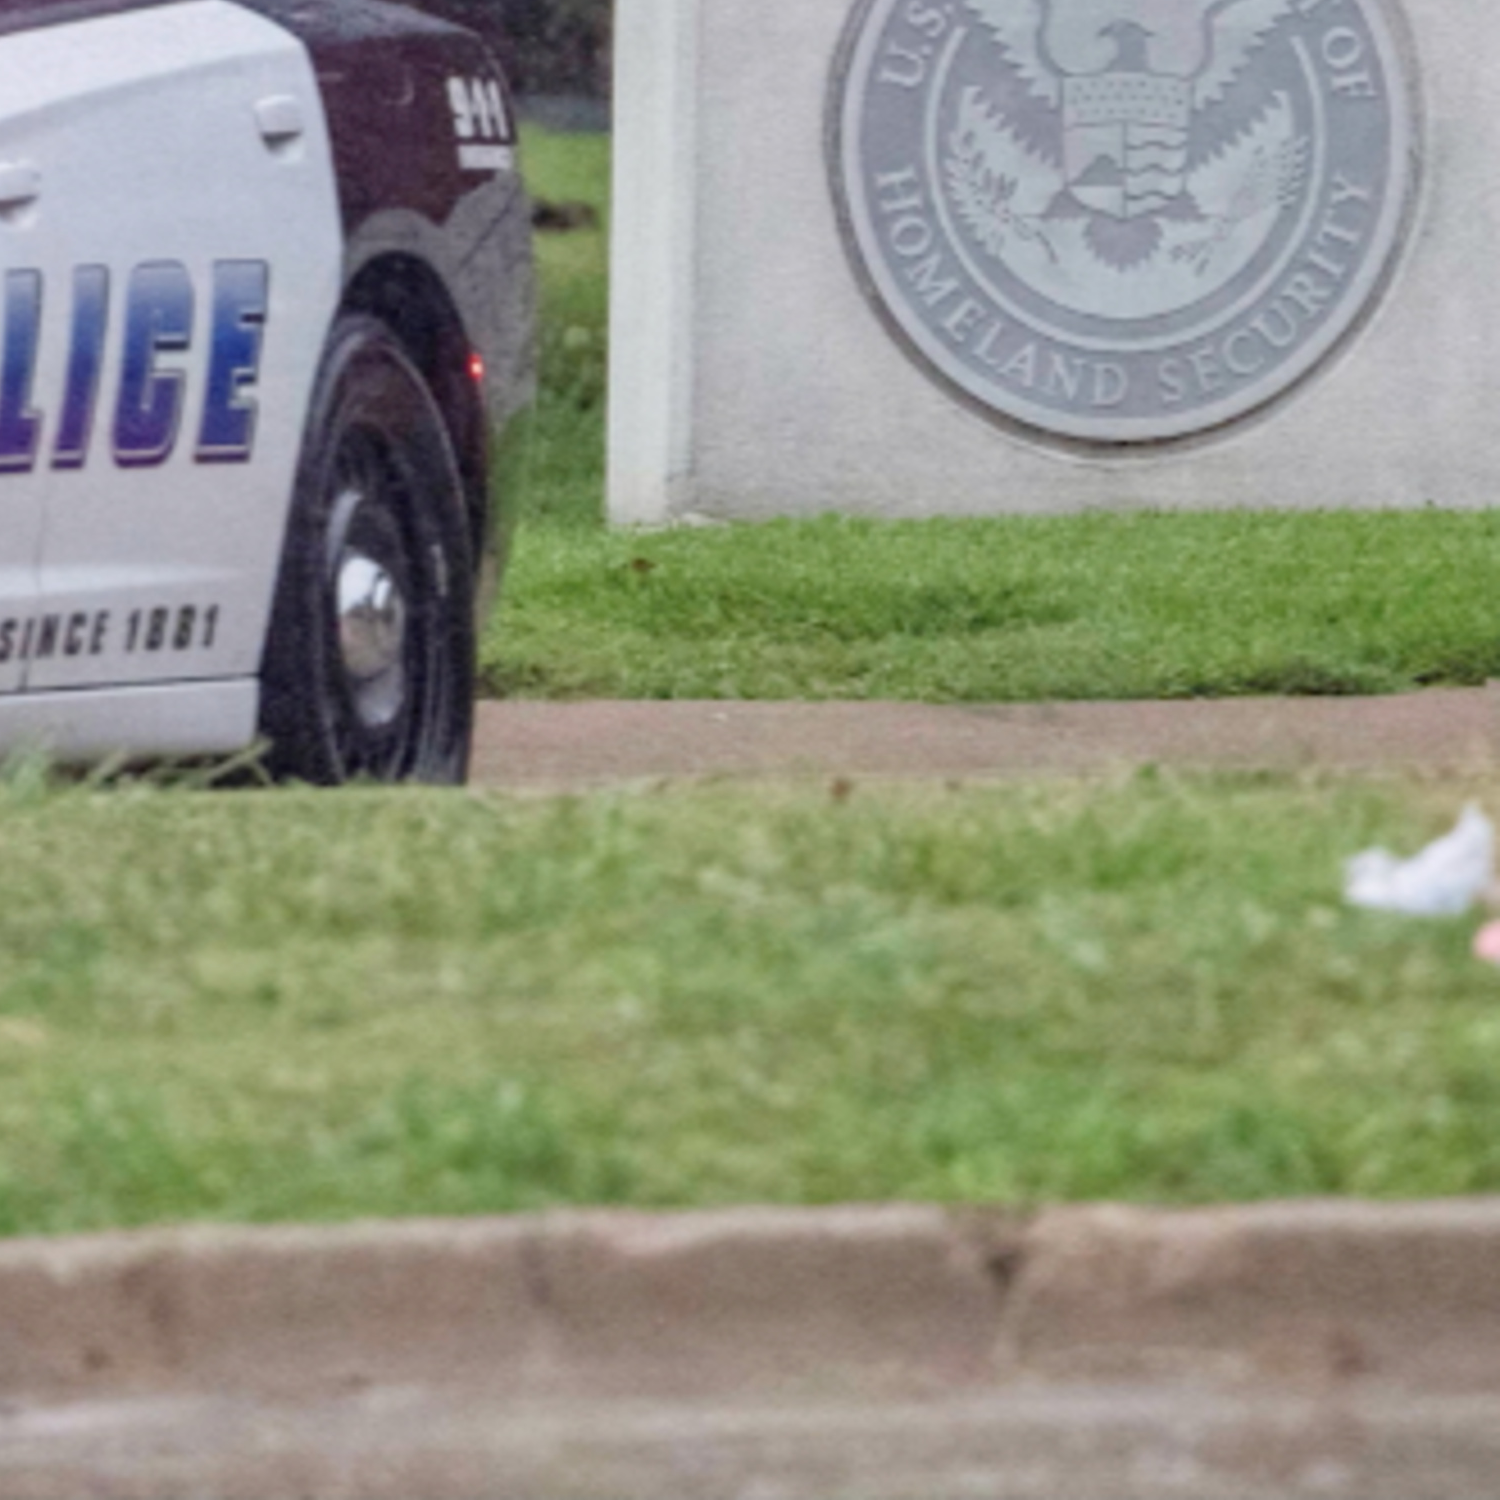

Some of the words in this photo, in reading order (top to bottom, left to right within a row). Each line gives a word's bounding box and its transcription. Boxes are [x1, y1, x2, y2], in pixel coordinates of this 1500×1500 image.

[1320, 25, 1377, 98] OF
[447, 76, 510, 140] 911
[874, 168, 1129, 408] HOMELAND
[1156, 173, 1372, 406] SECURITY
[123, 603, 220, 652] 1881
